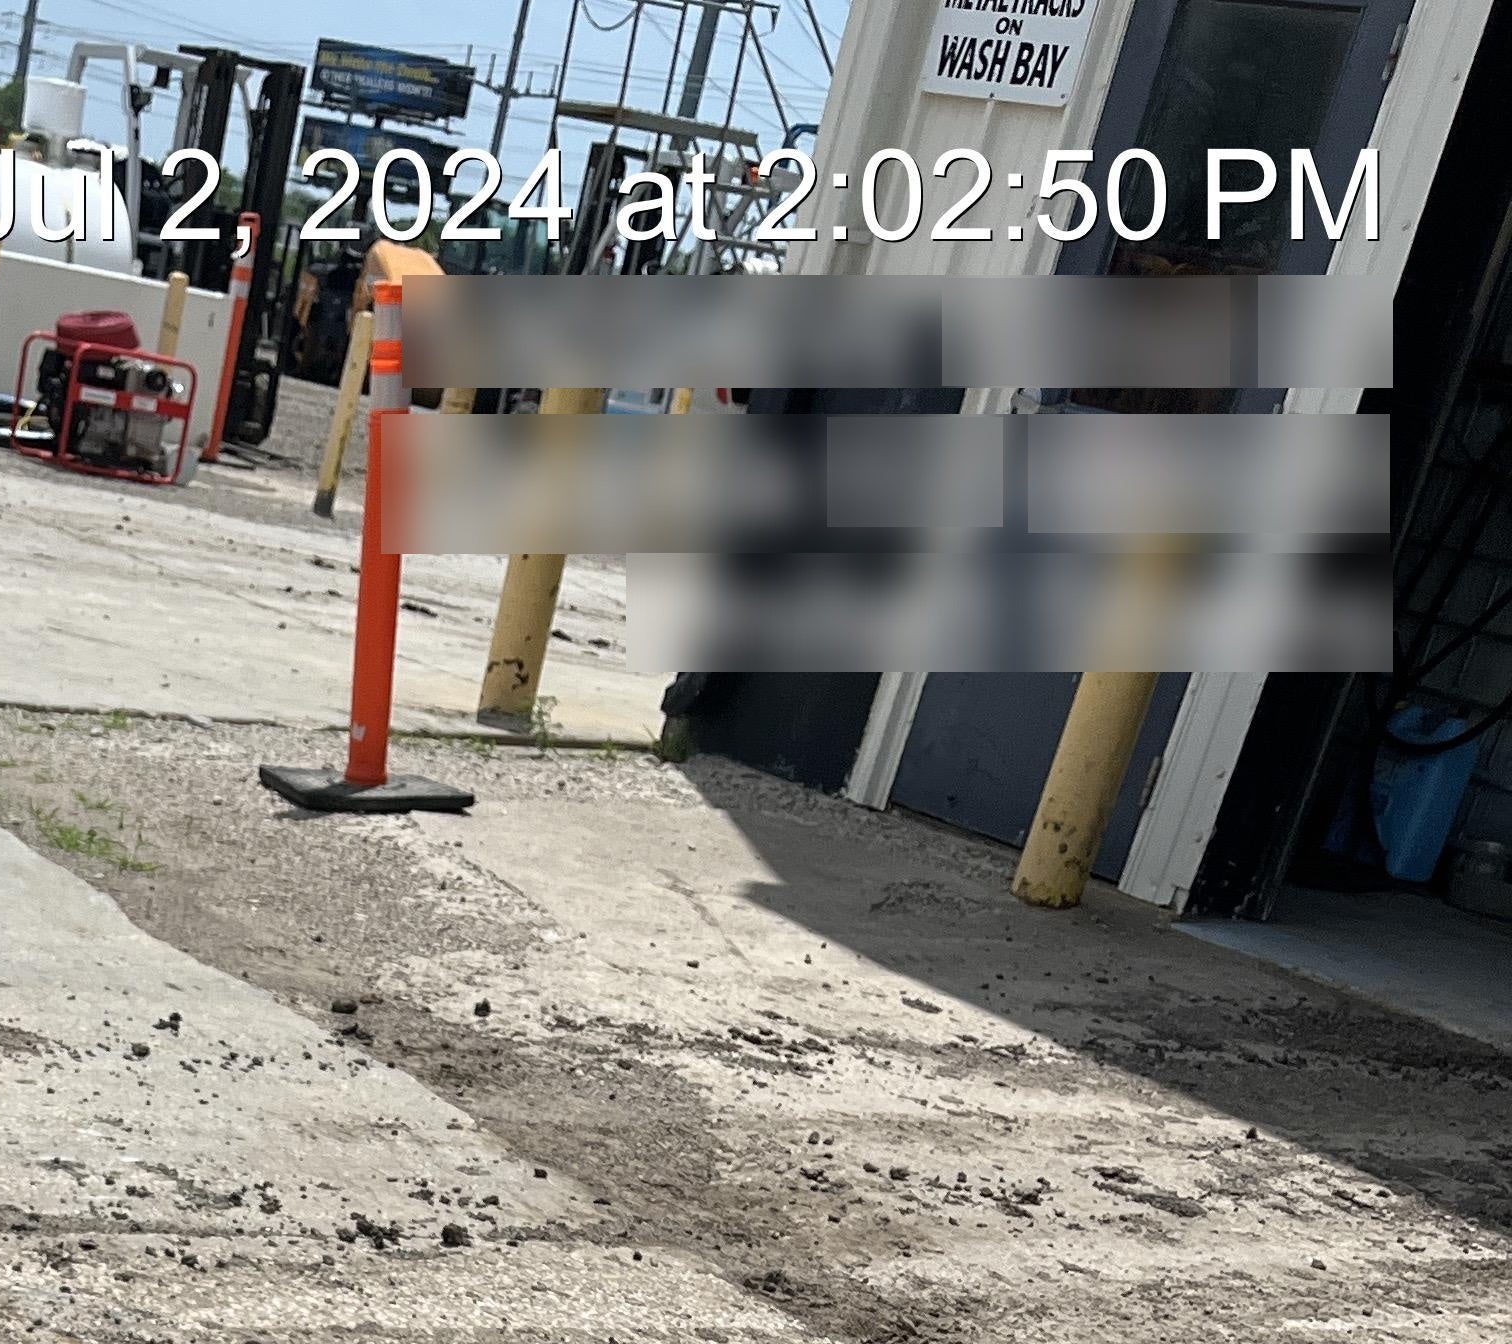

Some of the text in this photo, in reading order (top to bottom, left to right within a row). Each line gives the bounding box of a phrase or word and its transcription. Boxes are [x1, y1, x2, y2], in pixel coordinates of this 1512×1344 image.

[995, 16, 1024, 36] ON
[937, 34, 1070, 88] WASH BAY
